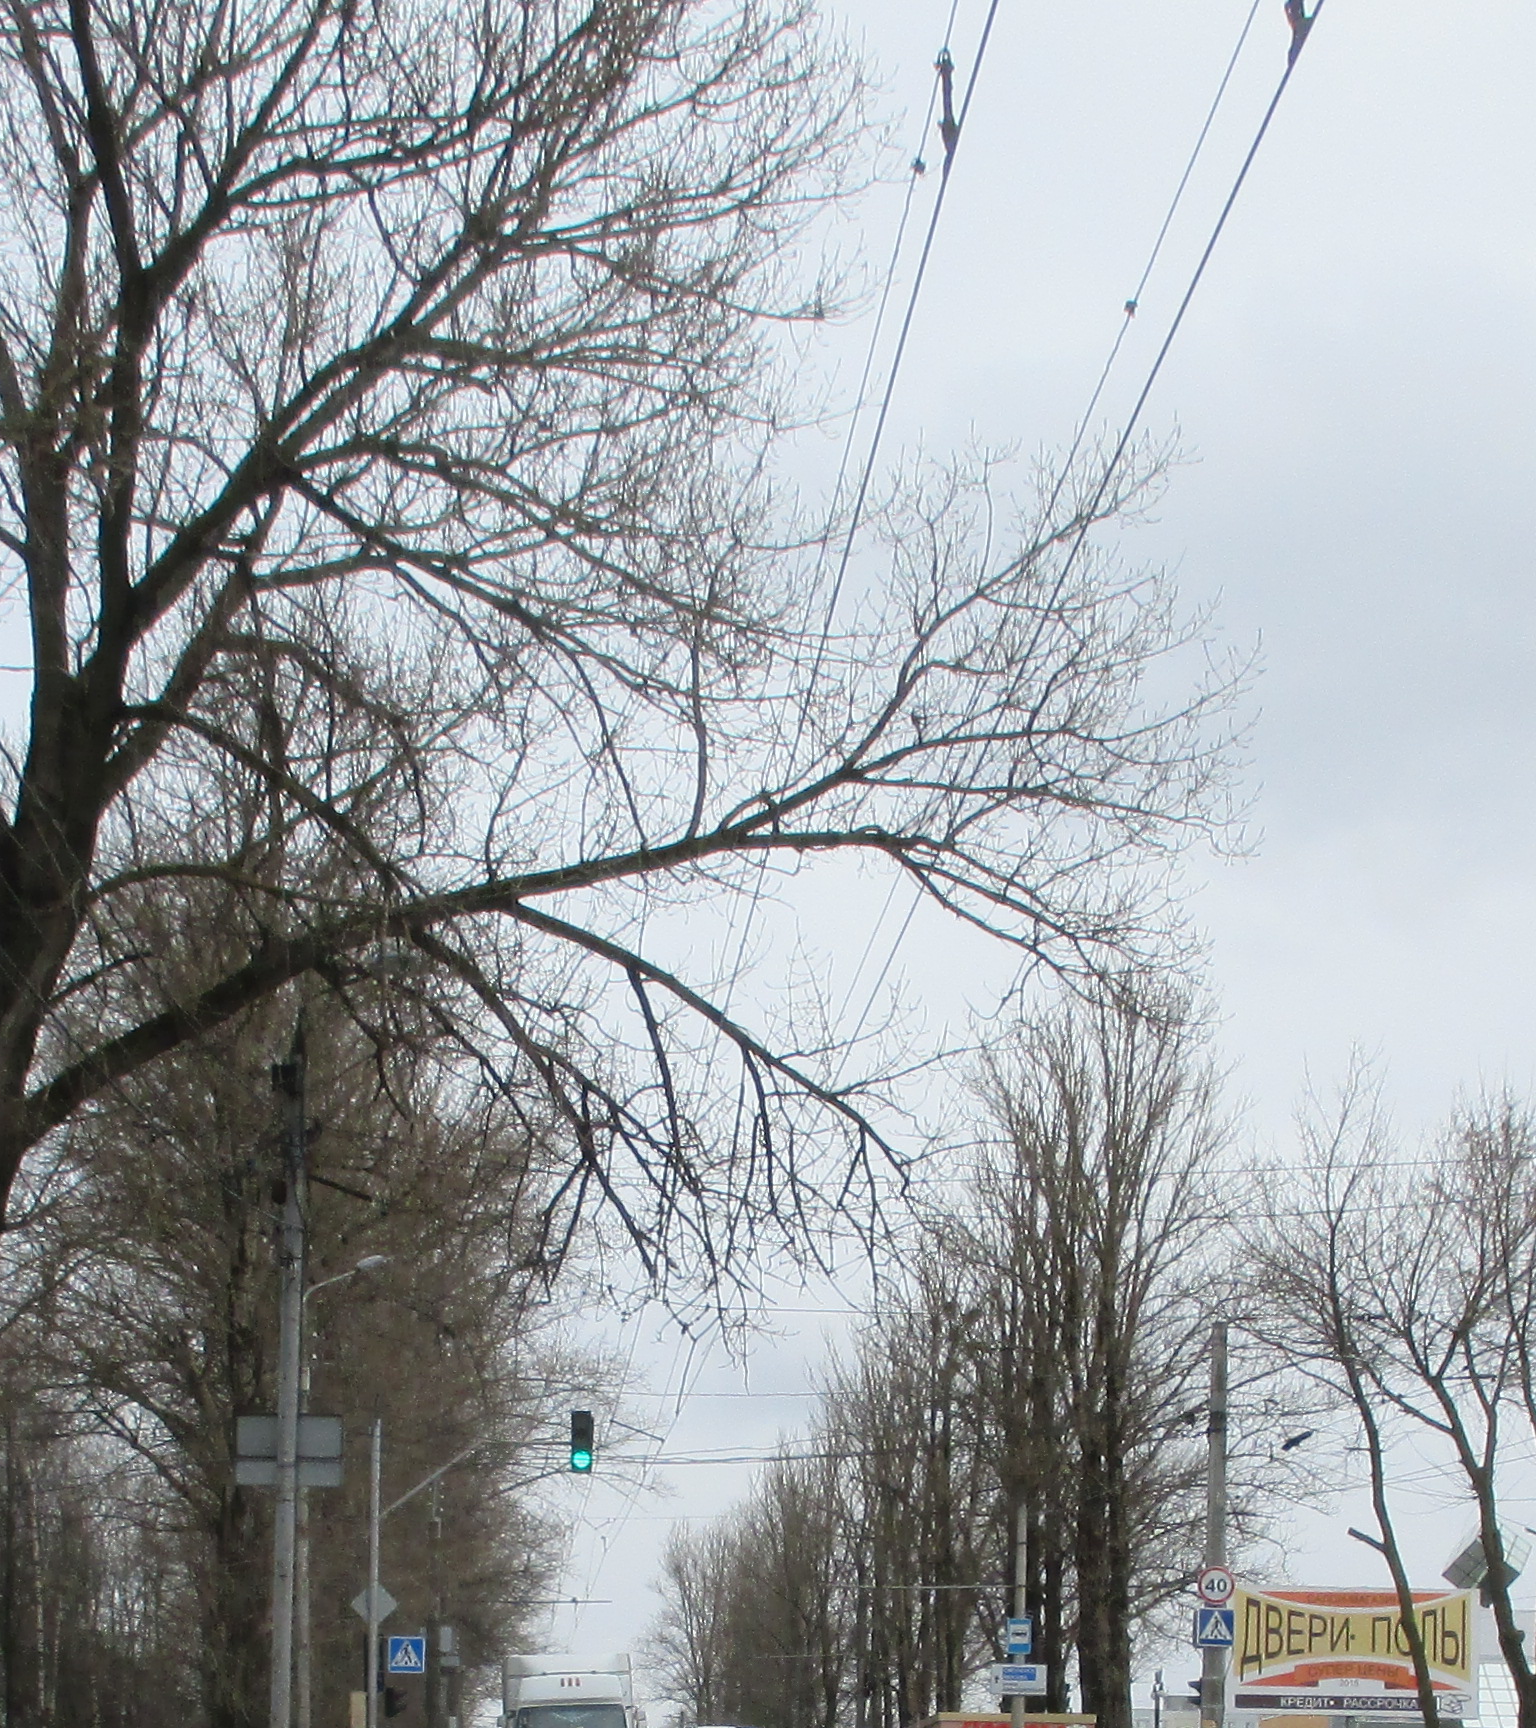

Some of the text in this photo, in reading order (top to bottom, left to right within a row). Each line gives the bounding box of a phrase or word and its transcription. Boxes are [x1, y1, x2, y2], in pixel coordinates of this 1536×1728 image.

[1205, 1578, 1227, 1592] 40
[1240, 1597, 1466, 1682] ДВЕРИ ПОЛЫ
[1280, 1696, 1418, 1710] КРЕДИТ РАССРОЧКА
